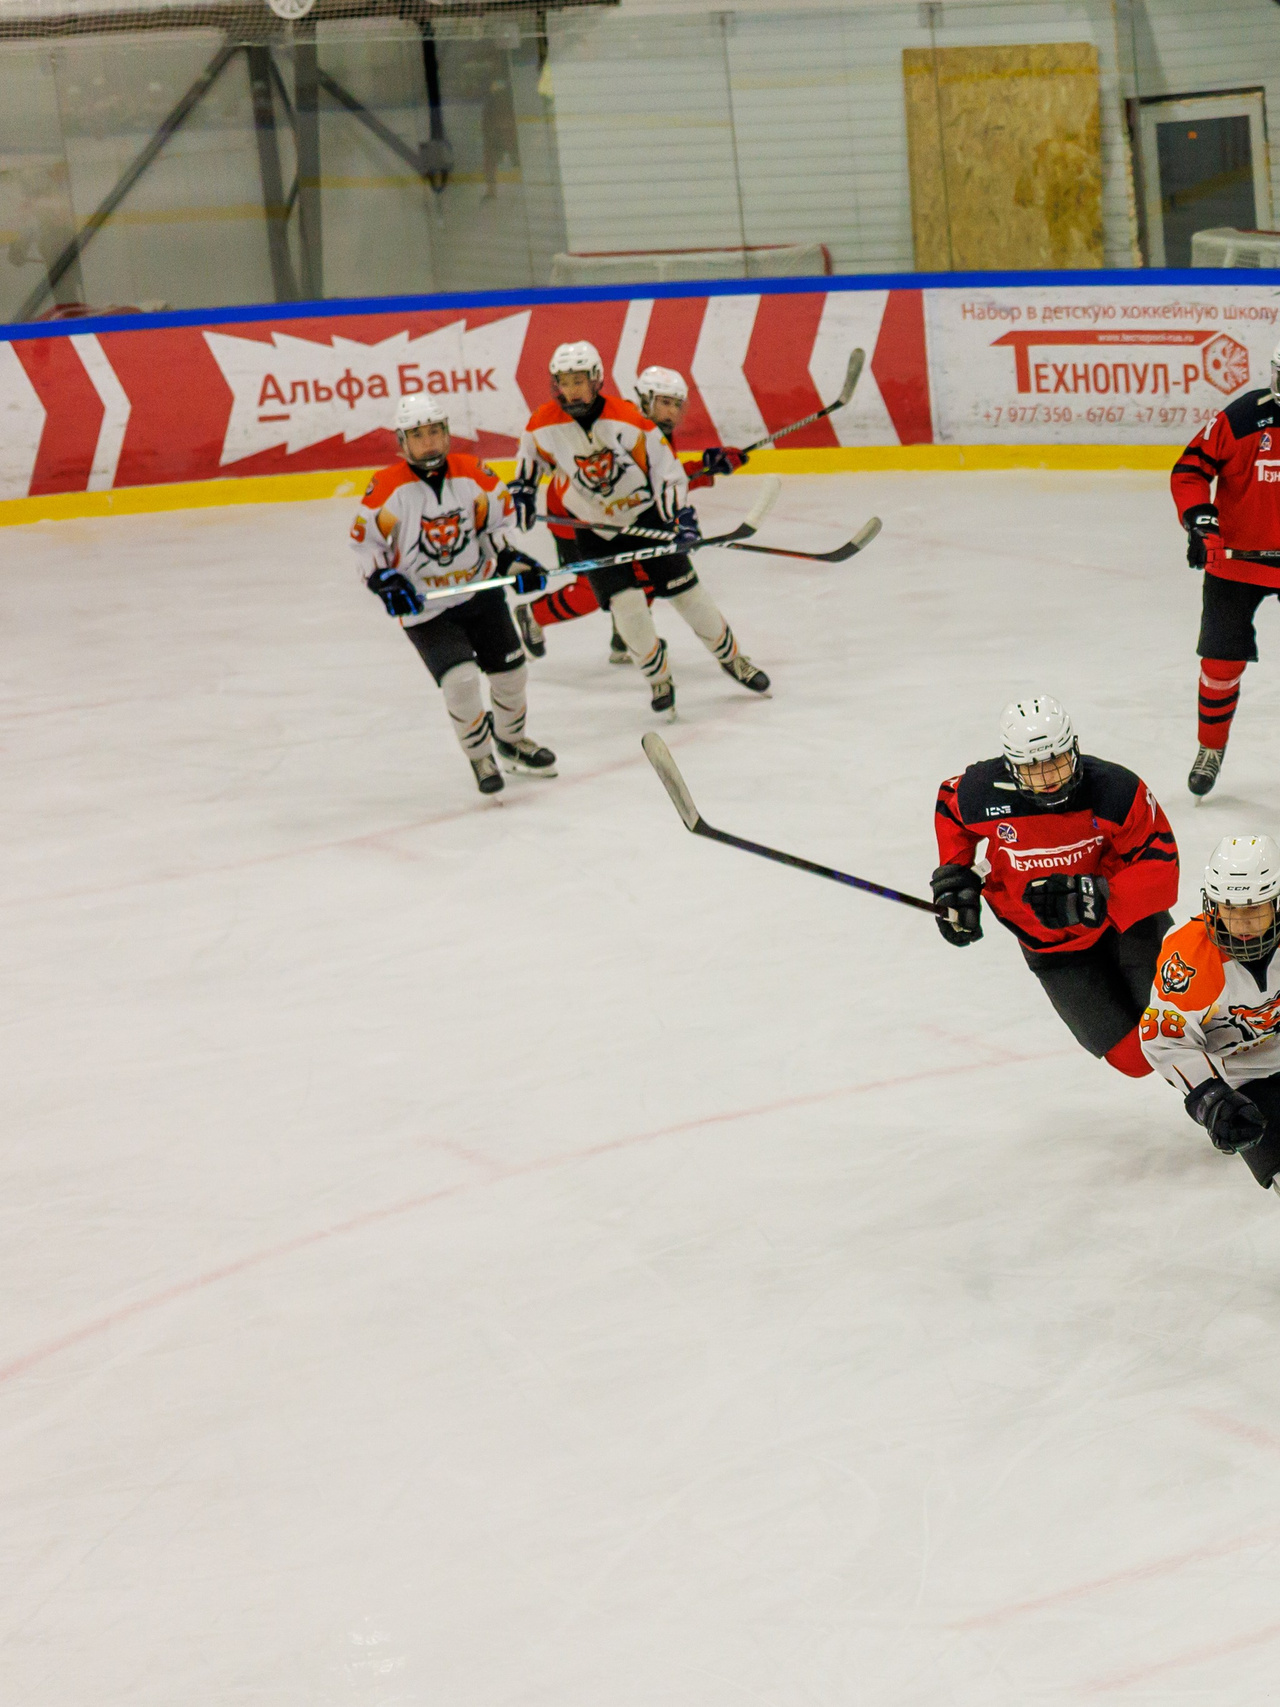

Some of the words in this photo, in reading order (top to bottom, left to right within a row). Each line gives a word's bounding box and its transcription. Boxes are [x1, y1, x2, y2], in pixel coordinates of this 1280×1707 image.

[961, 302, 1022, 324] Набор
[1027, 306, 1037, 320] в
[1042, 306, 1116, 324] детскую
[1120, 302, 1218, 324] хоккейную
[1223, 307, 1279, 325] школу
[258, 368, 389, 410] Альфа
[397, 363, 498, 396] Банк
[1008, 406, 1038, 423] 977
[1043, 406, 1072, 423] 350
[1086, 406, 1126, 424] 6767
[1159, 407, 1188, 424] 977
[614, 543, 678, 565] CCM
[1029, 743, 1054, 755] CCM
